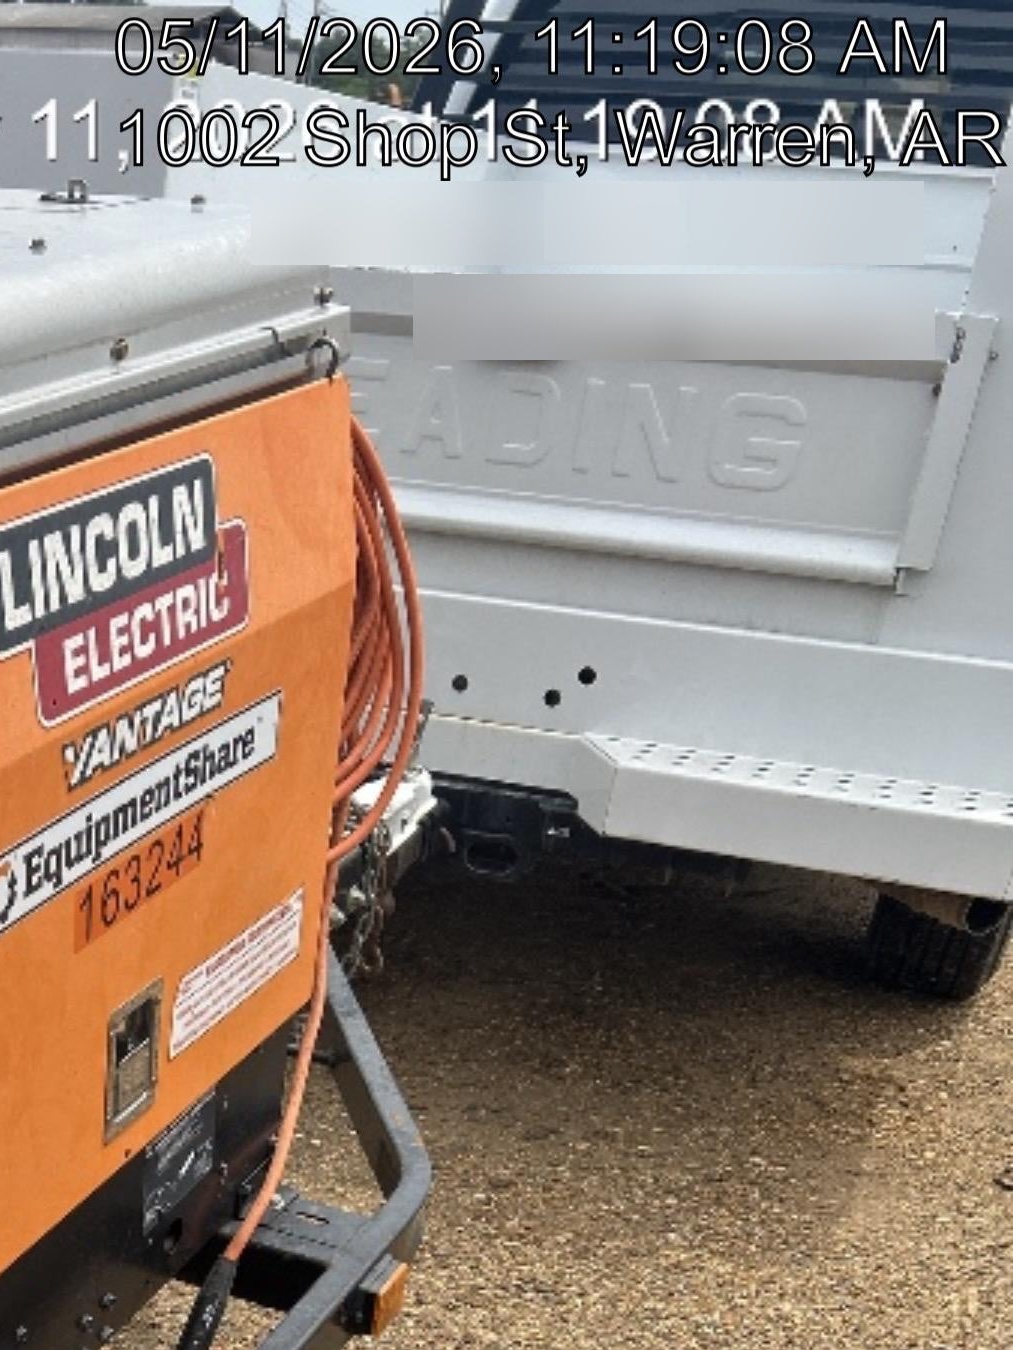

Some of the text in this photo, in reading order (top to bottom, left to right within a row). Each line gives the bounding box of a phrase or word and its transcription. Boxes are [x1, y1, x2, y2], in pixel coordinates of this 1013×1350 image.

[350, 356, 808, 493] EADING
[62, 570, 231, 695] ELECTRIC
[61, 663, 228, 792] VANTAGE
[23, 727, 255, 897] EquipmentShare
[79, 808, 205, 944] 163244
